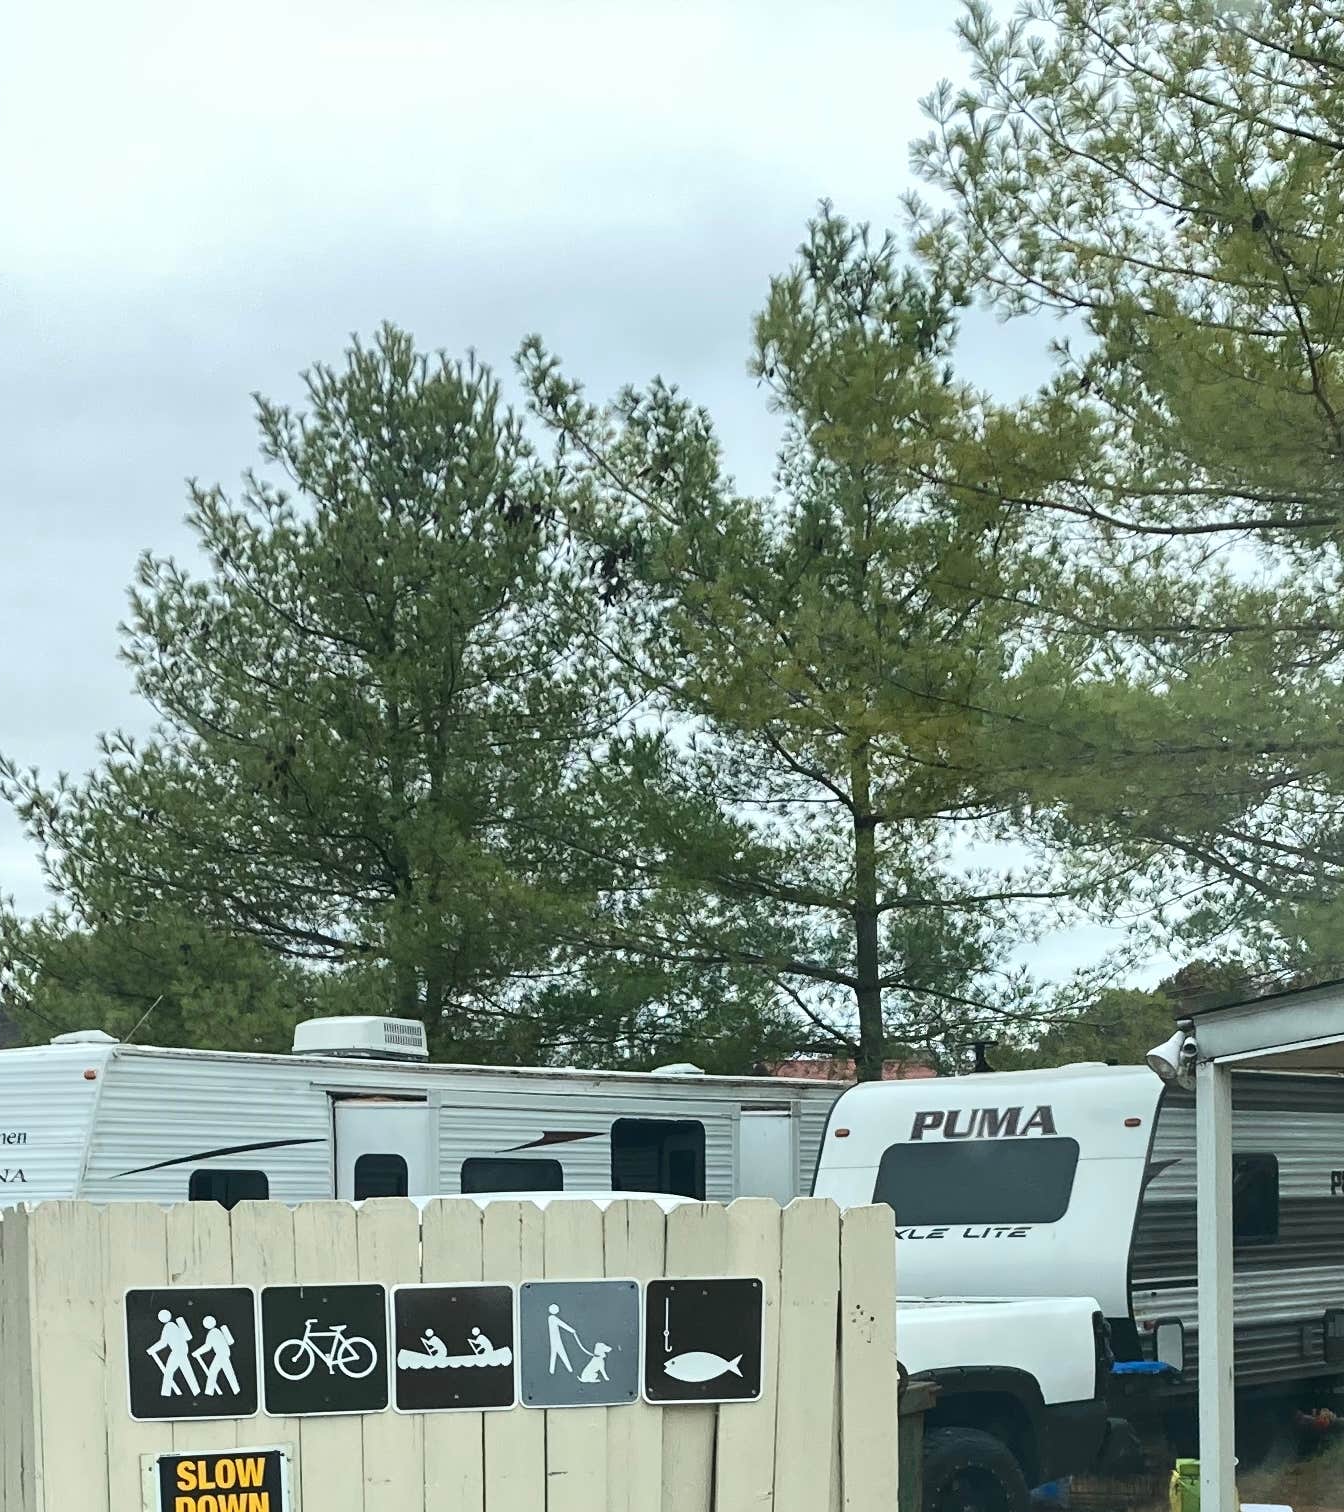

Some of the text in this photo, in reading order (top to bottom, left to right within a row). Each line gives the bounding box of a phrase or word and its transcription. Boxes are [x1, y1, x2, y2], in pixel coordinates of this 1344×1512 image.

[909, 1105, 1058, 1141] PUMA
[963, 1227, 1032, 1239] LITE
[176, 1457, 266, 1492] SLOW
